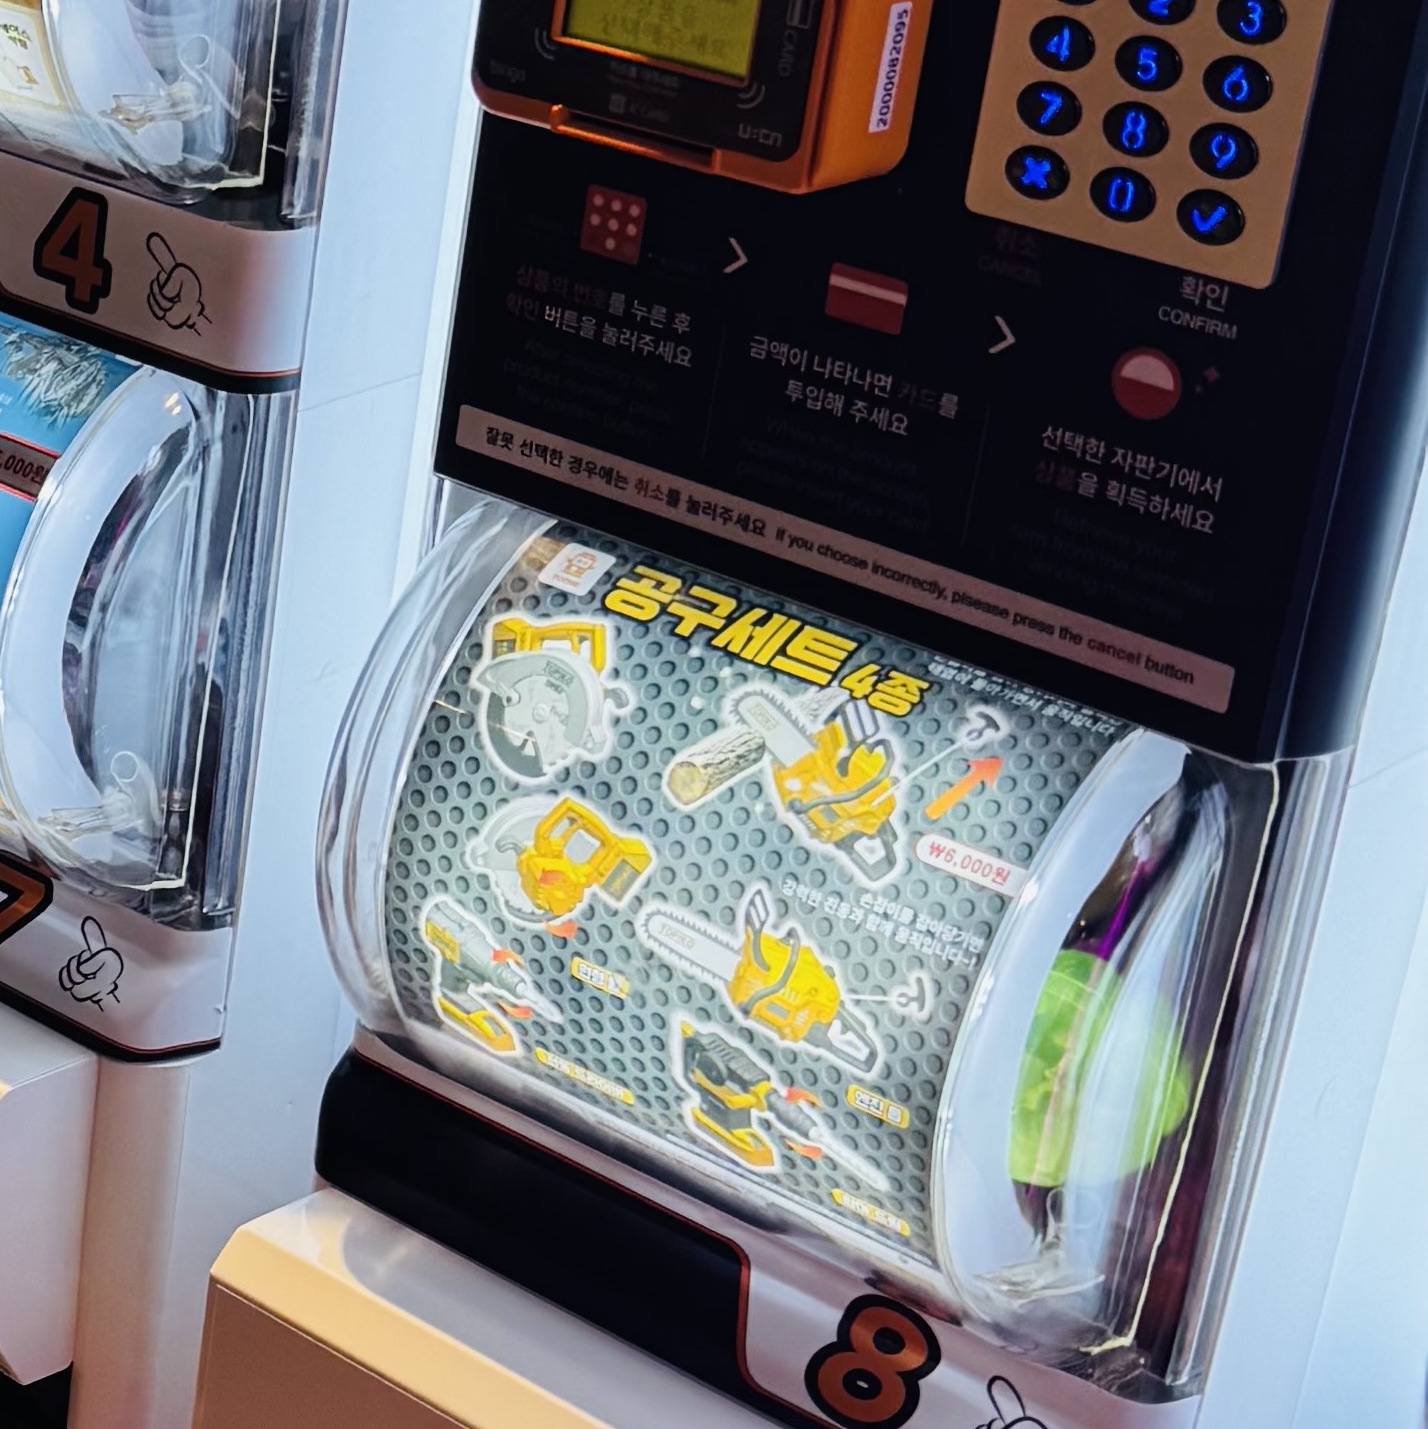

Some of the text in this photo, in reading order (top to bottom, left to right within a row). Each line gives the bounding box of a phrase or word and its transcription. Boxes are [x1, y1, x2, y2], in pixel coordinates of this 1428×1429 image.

[1239, 0, 1264, 37] 3
[1045, 25, 1071, 64] 4
[1136, 46, 1158, 83] 5
[1222, 65, 1250, 102] 6
[1039, 90, 1063, 125] 7
[1121, 110, 1146, 151] 8
[1209, 133, 1238, 171] 9
[1107, 176, 1135, 213] 0
[32, 186, 113, 315] 4
[1179, 274, 1230, 314] 확인
[544, 303, 597, 341] 버튼을
[601, 322, 694, 369] 눌러주세요
[631, 298, 670, 330] 누른
[671, 312, 693, 336] 후
[1157, 305, 1239, 341] CONFIRM
[749, 334, 809, 373] 금액이
[812, 353, 894, 399] 나타나면
[785, 378, 909, 437] 투입해 주세요
[1041, 424, 1224, 504] 선택한 자판기에서
[1104, 478, 1216, 535] 획득하세요
[484, 425, 515, 452] 잘못
[518, 438, 564, 468] 선택한
[566, 454, 630, 491] 경우에는
[634, 476, 682, 509] 취소를
[684, 493, 767, 538] 눌러주세요
[788, 531, 815, 555] you
[817, 540, 869, 572] choose
[870, 558, 949, 601] incorrectly,
[1011, 608, 1056, 639] press
[1057, 623, 1085, 647] the
[1086, 634, 1144, 667] cancel
[1143, 653, 1196, 687] button
[601, 562, 933, 720] 공구세트 4종
[780, 878, 823, 908] 강력한
